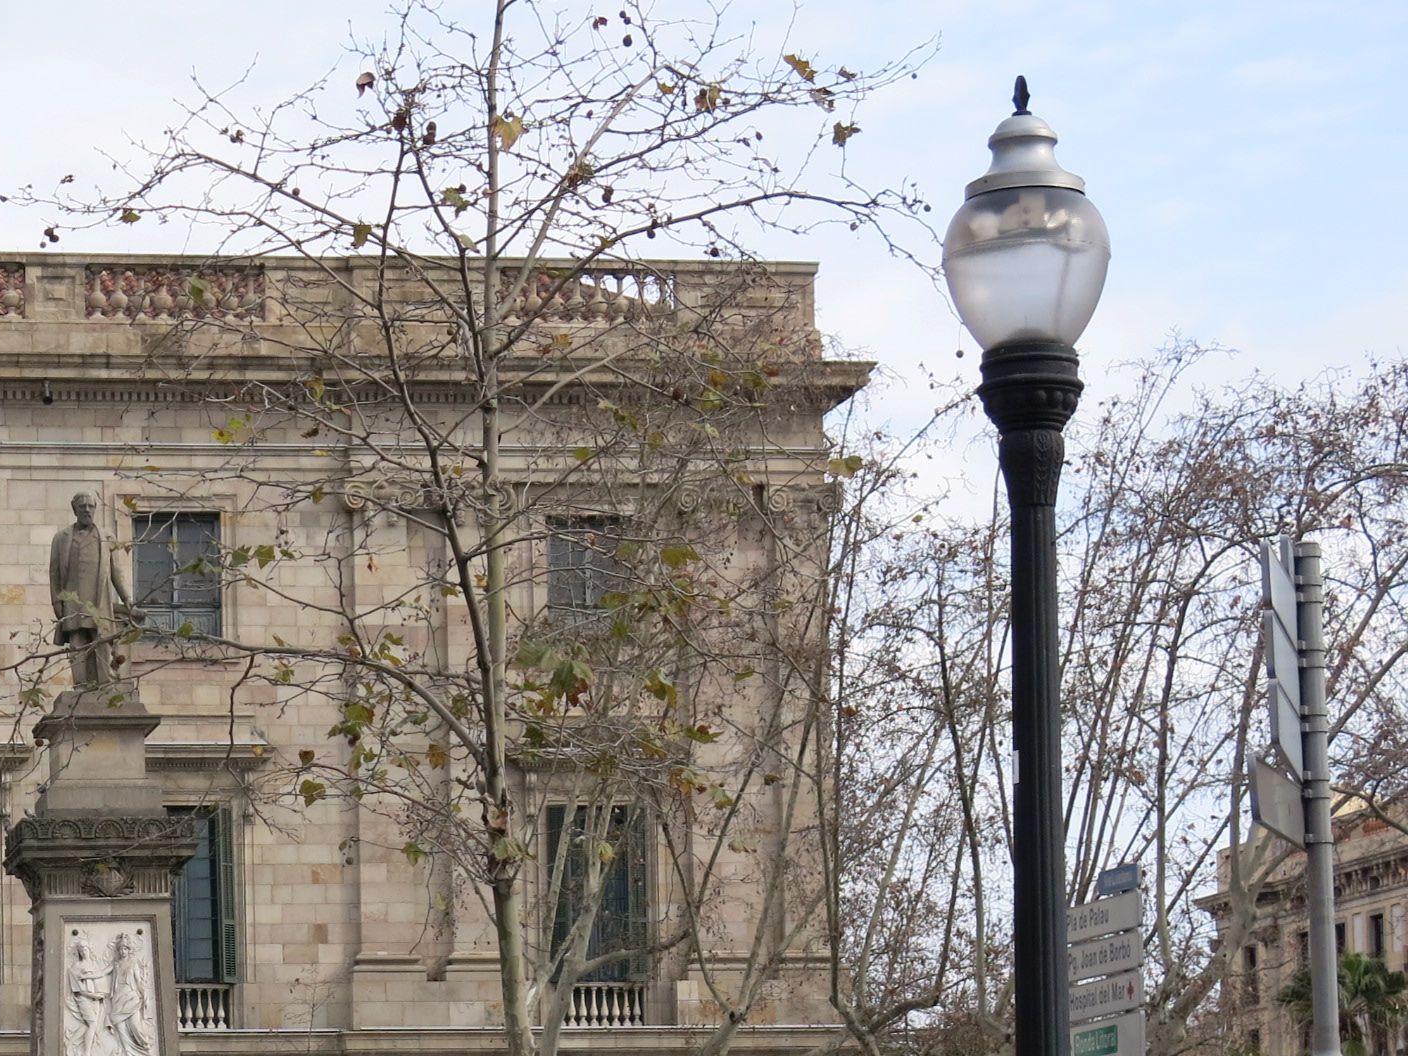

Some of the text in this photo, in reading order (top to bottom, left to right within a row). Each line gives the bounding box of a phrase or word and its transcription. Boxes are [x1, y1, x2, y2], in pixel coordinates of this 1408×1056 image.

[1079, 910, 1087, 929] de
[1089, 905, 1109, 927] Palau
[1081, 949, 1098, 970] Joan
[1099, 945, 1107, 964] de
[1099, 984, 1110, 1005] del
[1112, 982, 1125, 1001] Mar
